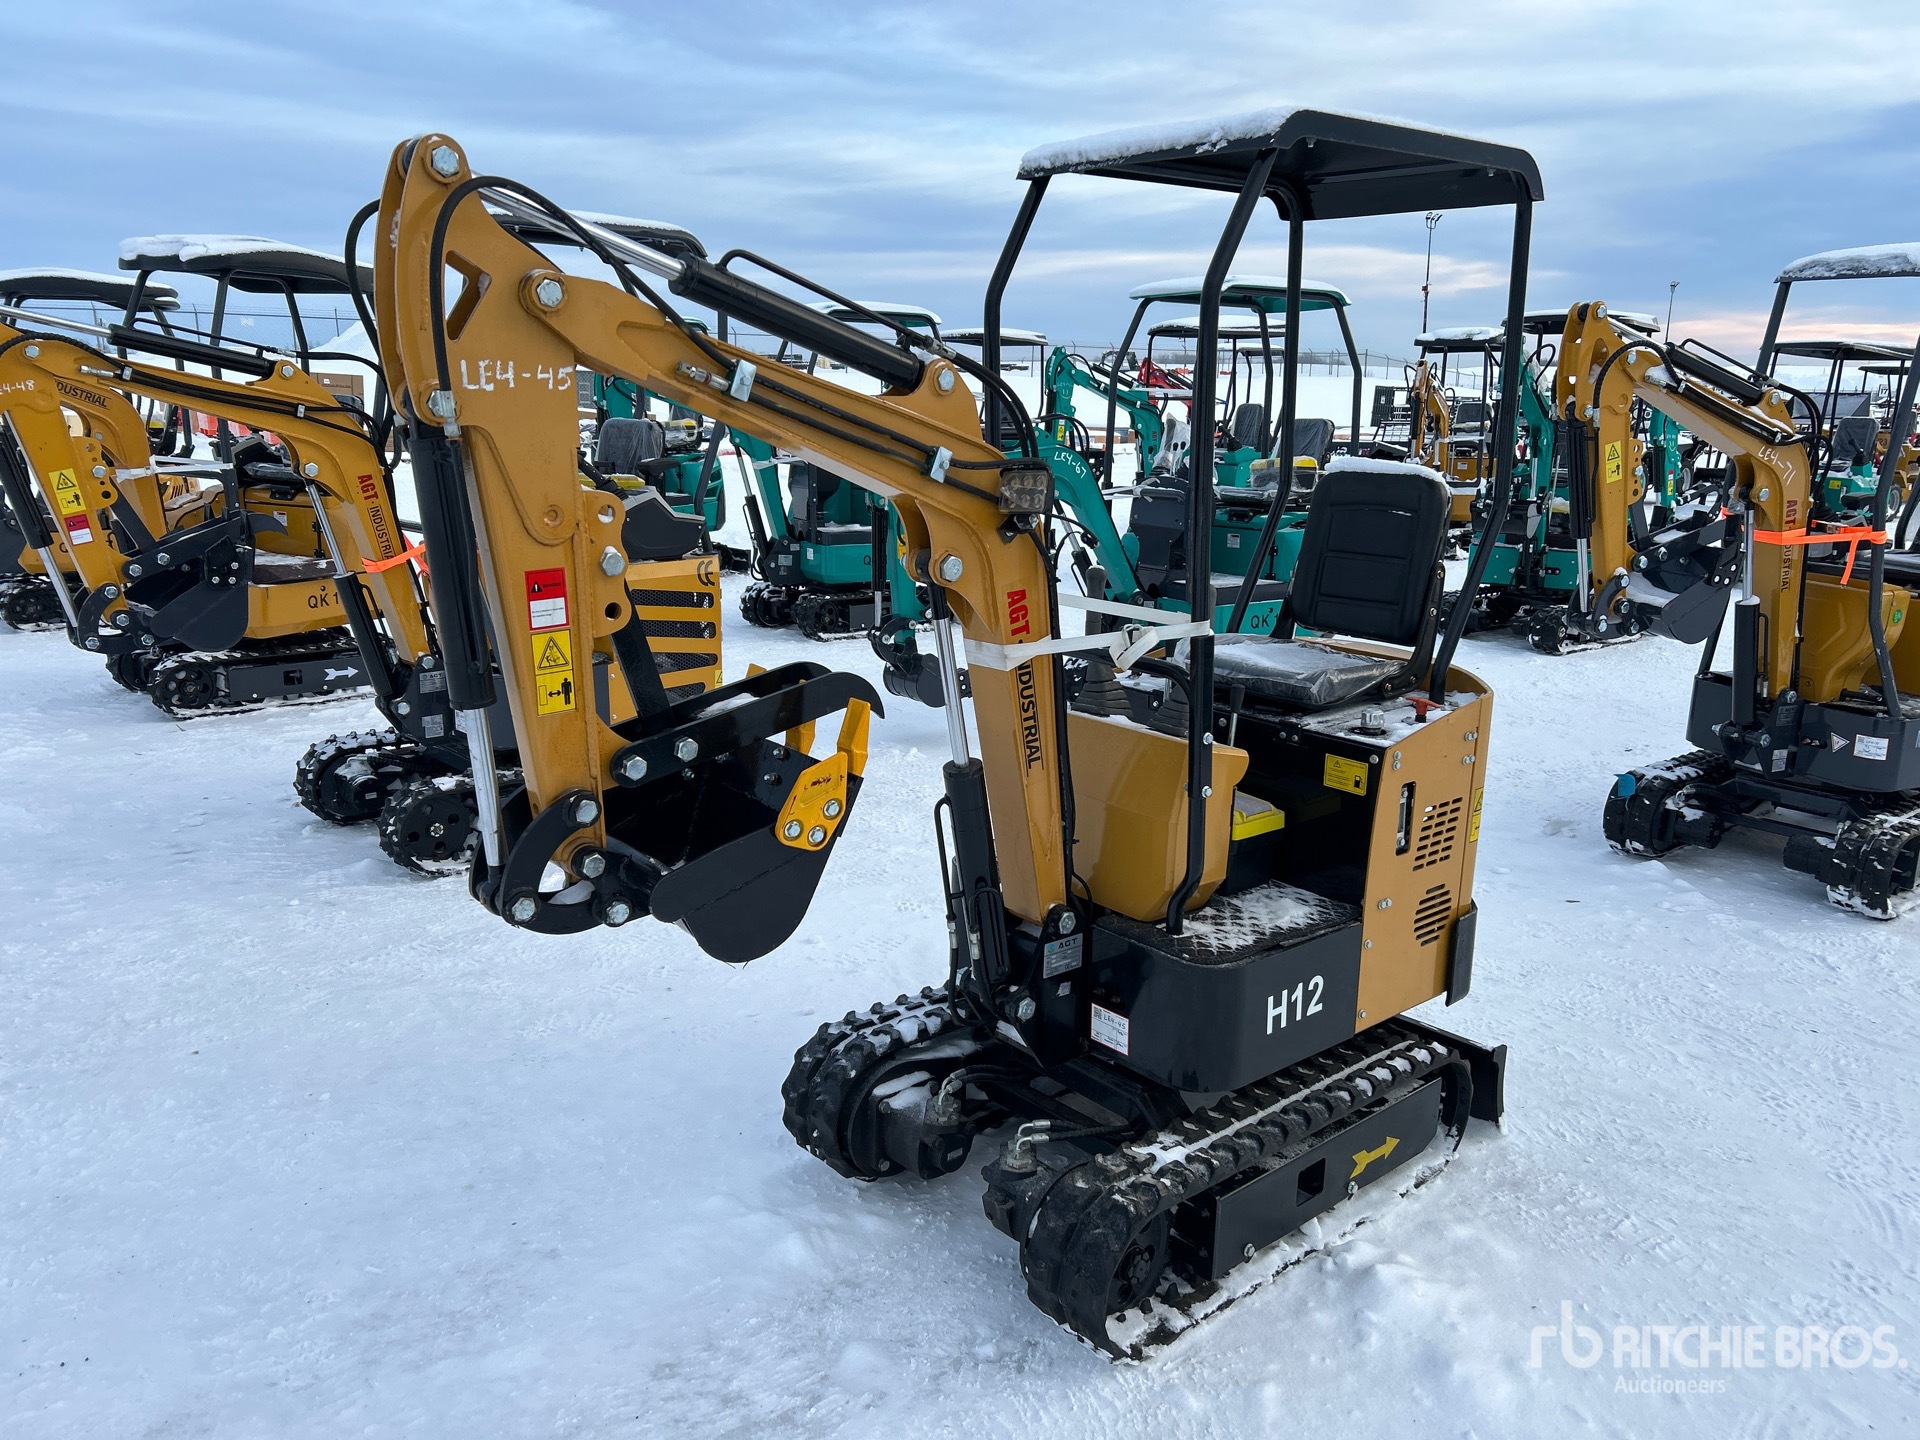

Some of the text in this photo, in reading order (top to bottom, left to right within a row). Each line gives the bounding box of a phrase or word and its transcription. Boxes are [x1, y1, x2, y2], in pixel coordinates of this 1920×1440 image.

[0, 380, 35, 395] 4-48
[460, 359, 574, 391] LE4-45
[55, 381, 108, 408] DUSTRIAL
[357, 474, 395, 560] AGT INDUSTRIA
[1784, 499, 1798, 526] AGT
[307, 593, 330, 609] QK
[1250, 613, 1270, 629] QK
[1006, 588, 1042, 770] AGT NDUSTRIAL
[1058, 938, 1078, 949] AGT
[1266, 974, 1324, 1036] H12
